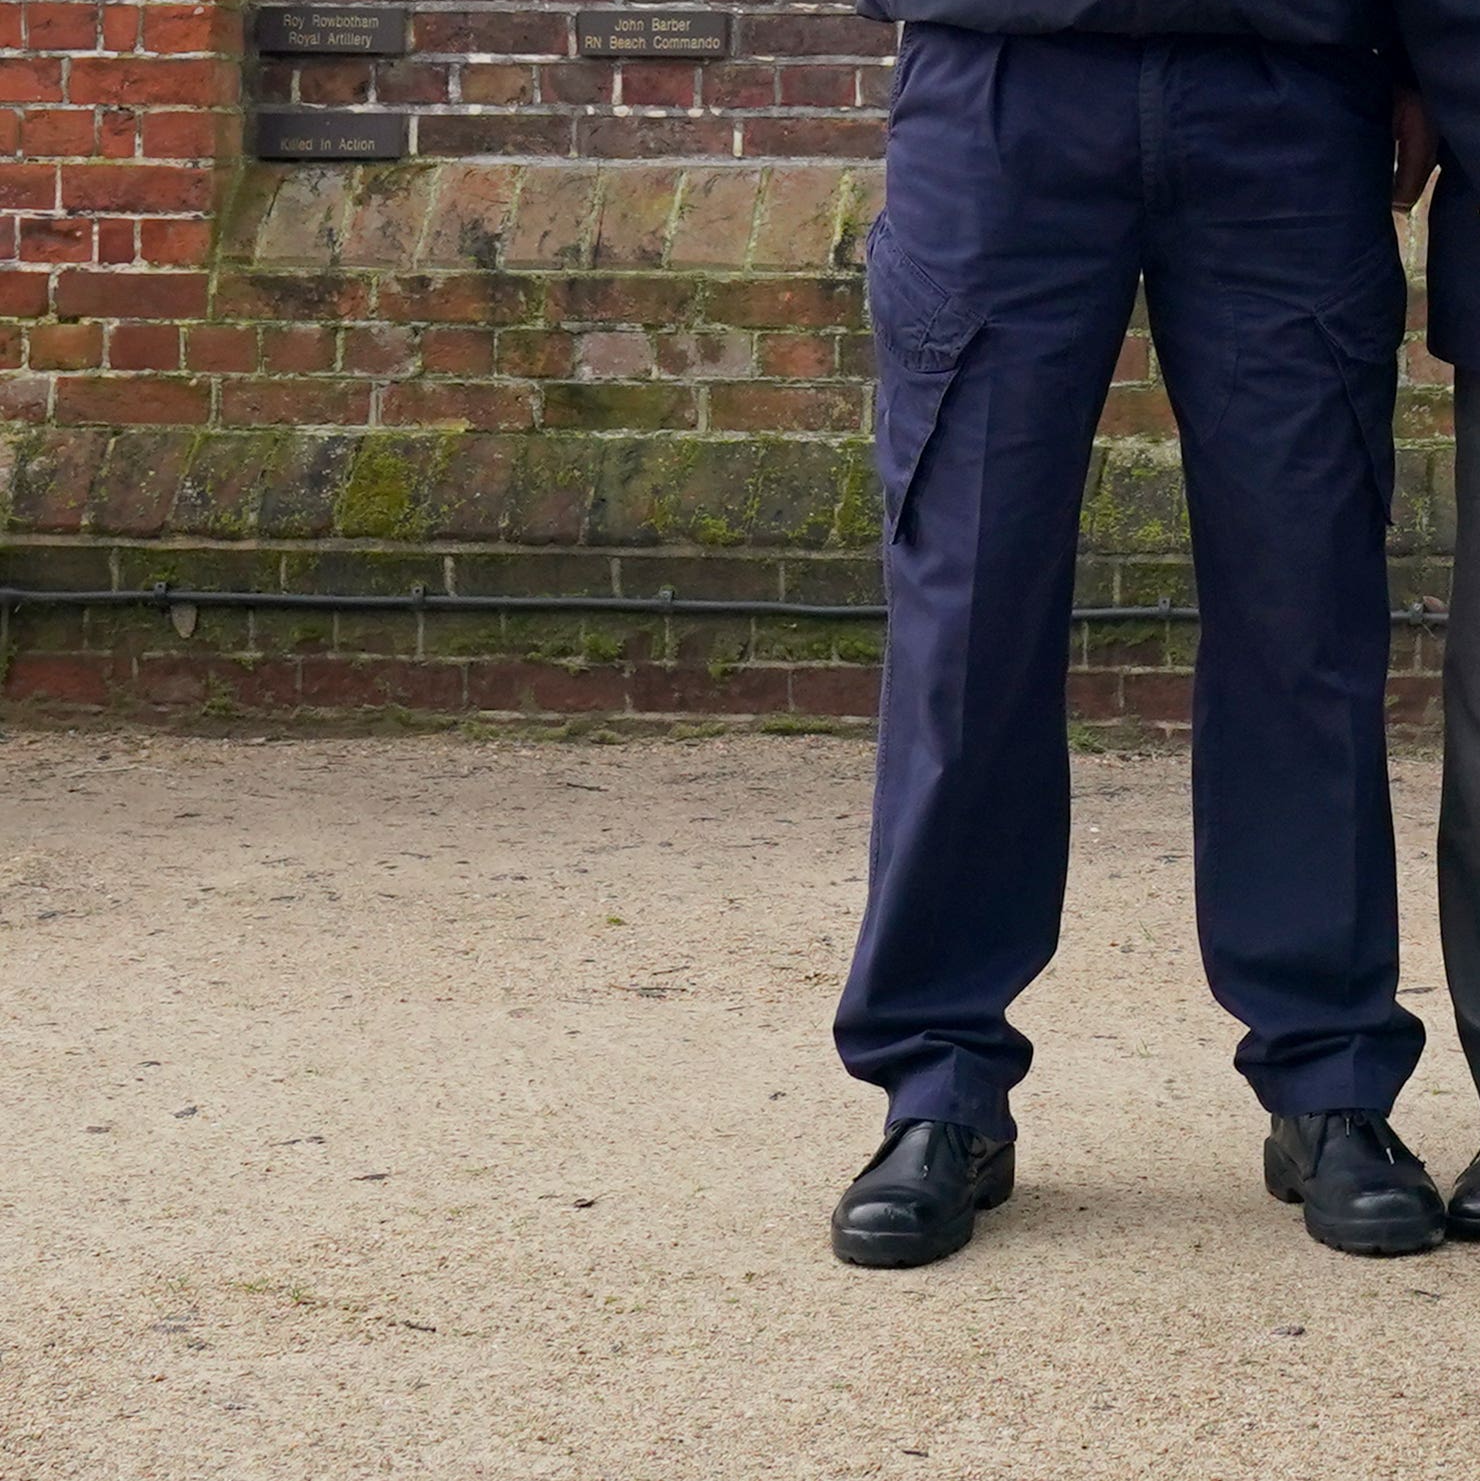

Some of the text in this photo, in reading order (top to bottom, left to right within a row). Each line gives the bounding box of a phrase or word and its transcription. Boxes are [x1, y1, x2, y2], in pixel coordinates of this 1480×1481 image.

[283, 13, 380, 29] Roy Rowbotham
[614, 17, 692, 32] John Barber
[288, 31, 373, 48] Royal Artillery
[584, 35, 721, 49] RN Beach Commando
[280, 138, 313, 151] Killed
[338, 138, 376, 151] Action
